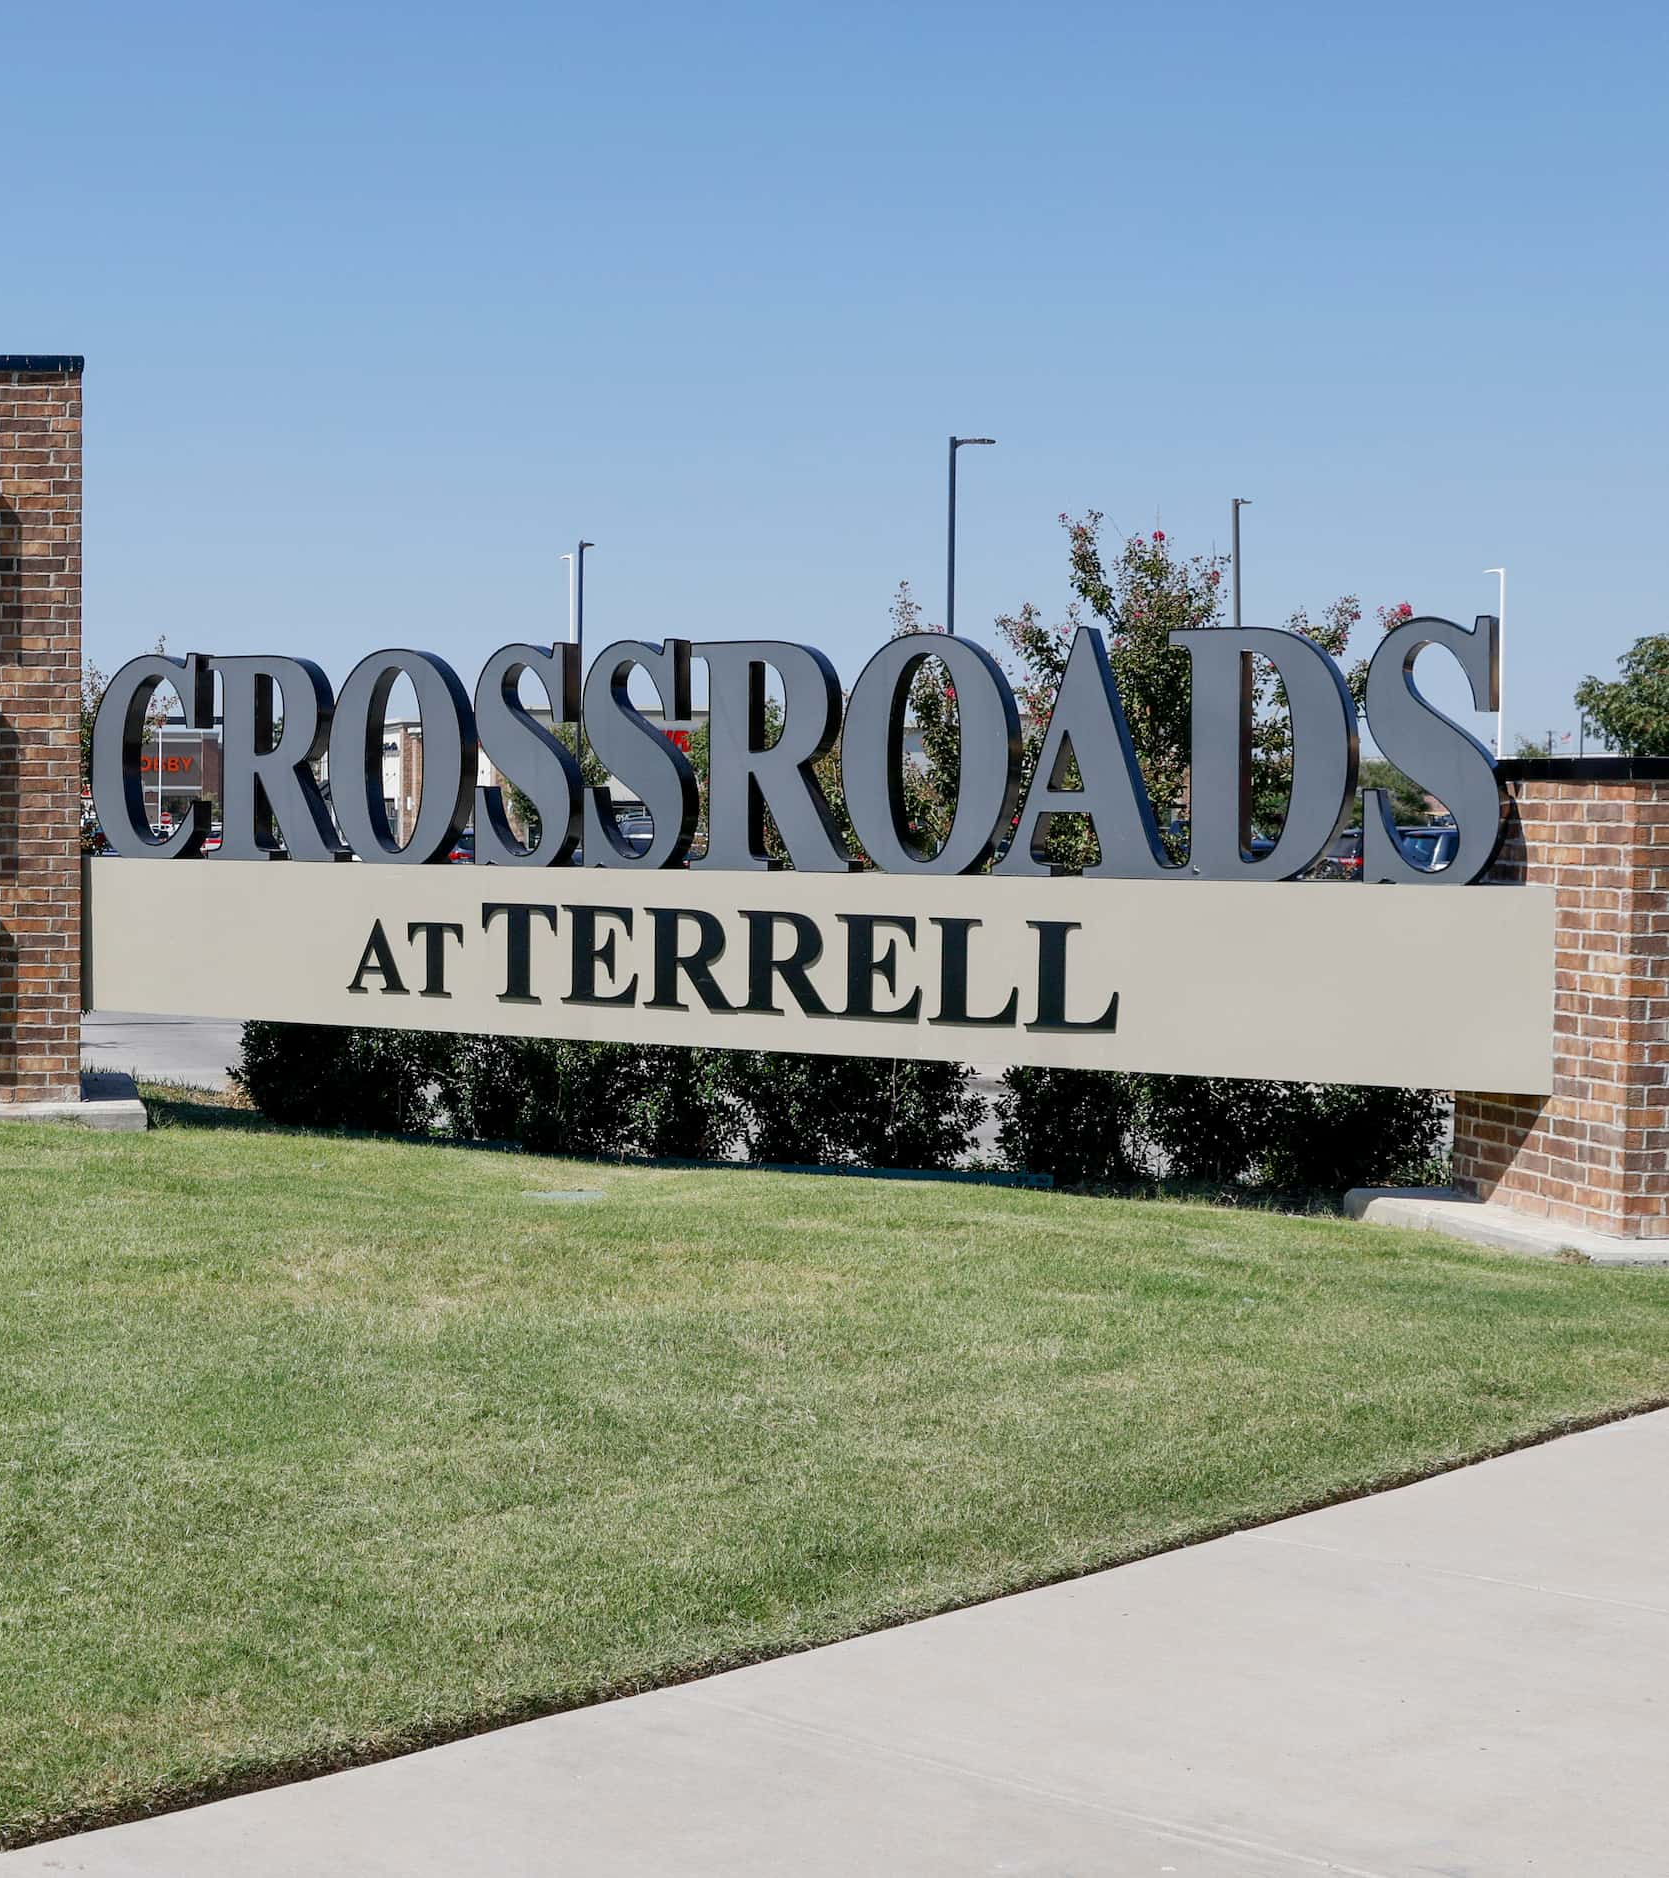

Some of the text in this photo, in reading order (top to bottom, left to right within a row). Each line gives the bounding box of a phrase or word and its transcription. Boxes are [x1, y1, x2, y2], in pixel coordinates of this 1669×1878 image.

[93, 615, 1504, 884] CROSSROADS
[346, 901, 1120, 1034] AT TERRELL
